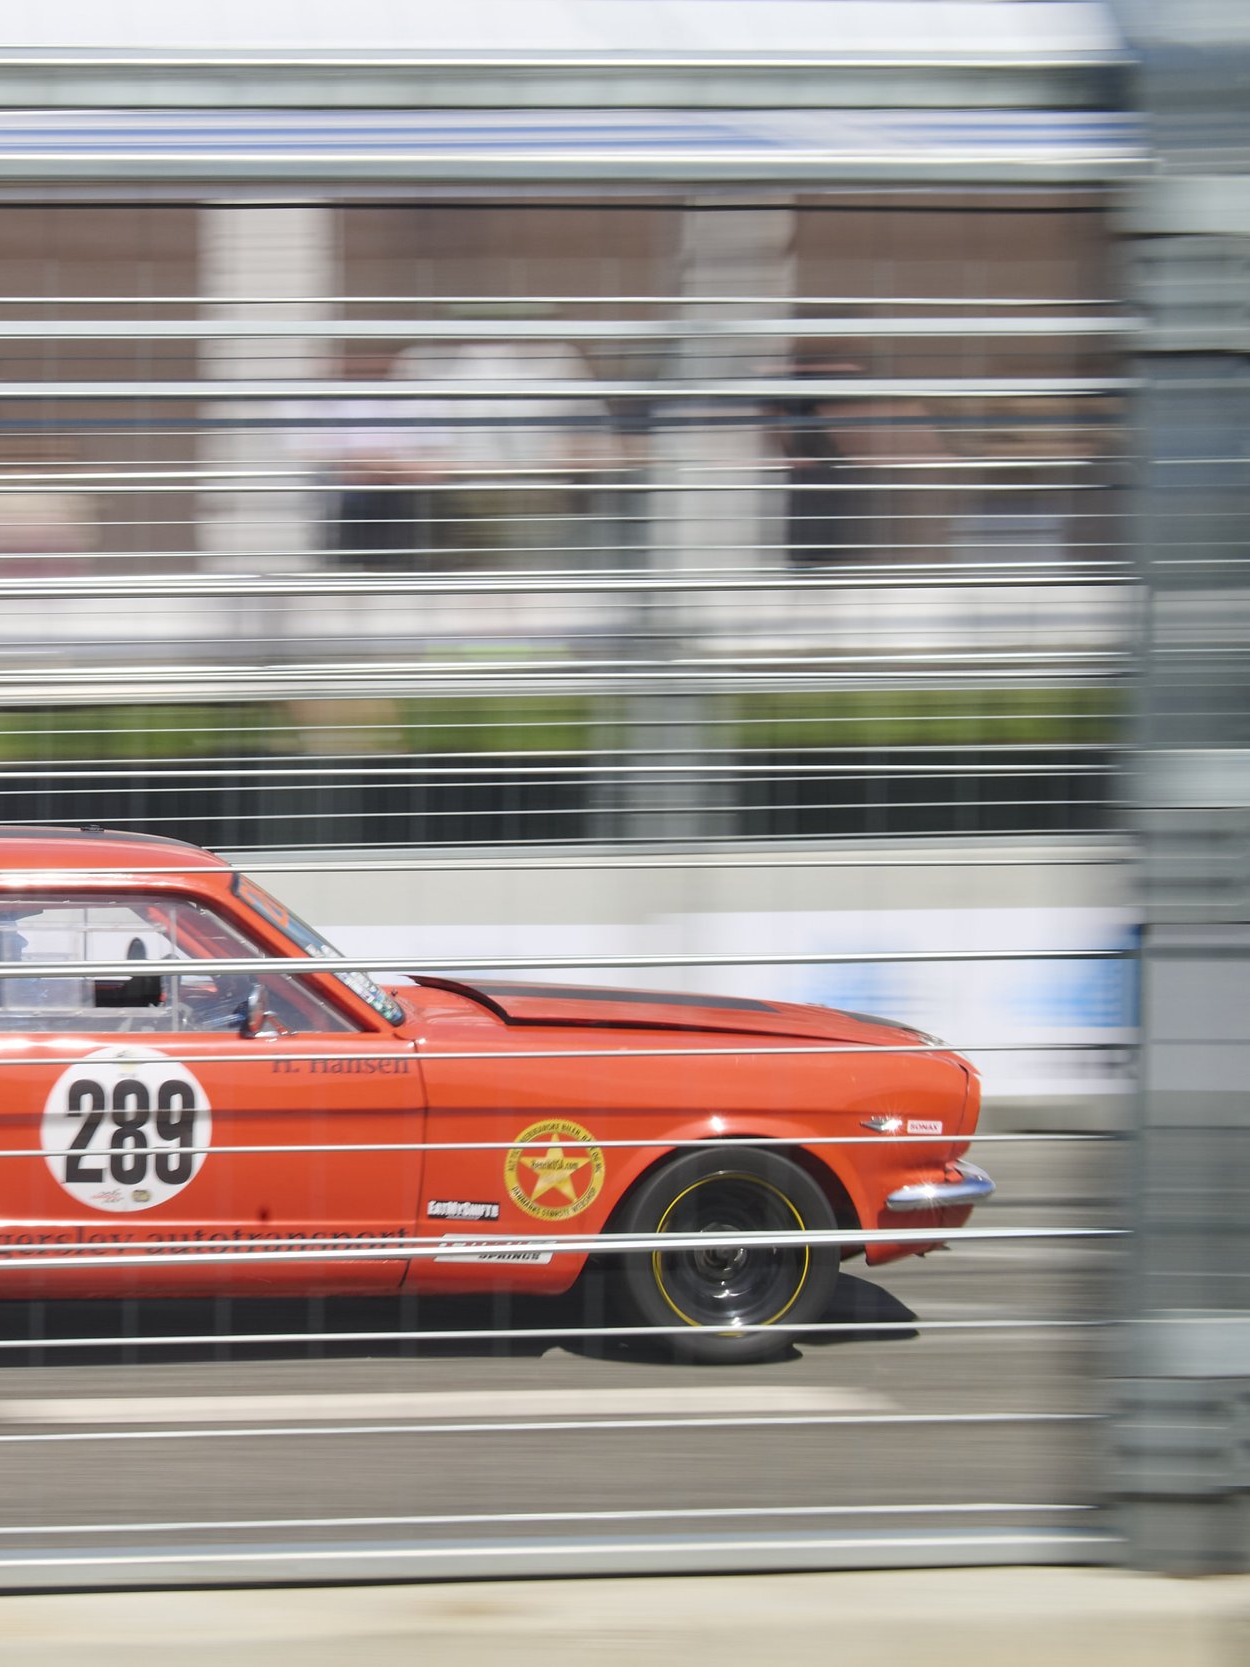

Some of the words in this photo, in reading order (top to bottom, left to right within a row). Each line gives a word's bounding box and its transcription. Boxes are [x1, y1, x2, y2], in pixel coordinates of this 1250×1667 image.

[309, 1053, 411, 1075] Hansen
[65, 1078, 195, 1185] 289
[910, 1122, 939, 1132] SONAX
[146, 1227, 410, 1257] autotransport
